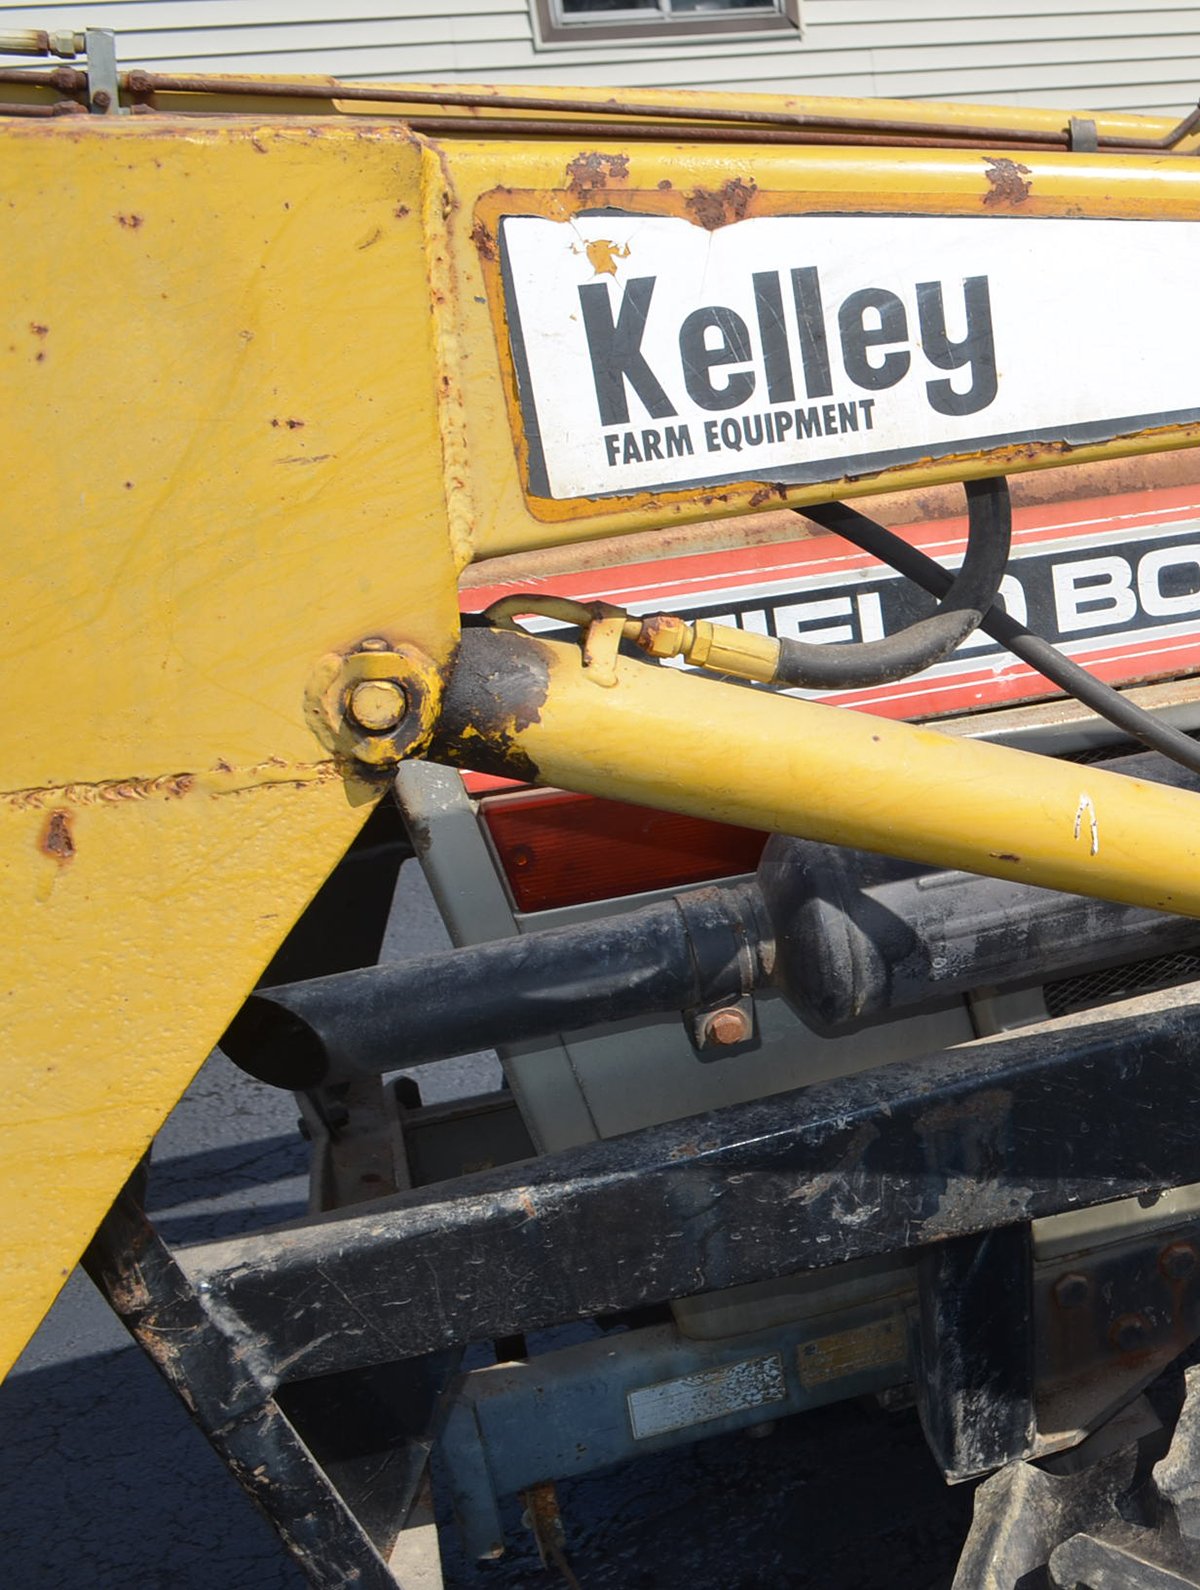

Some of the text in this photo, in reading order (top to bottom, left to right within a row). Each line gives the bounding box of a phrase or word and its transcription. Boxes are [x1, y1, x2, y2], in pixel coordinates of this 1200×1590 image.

[577, 266, 998, 426] Kelley
[604, 398, 875, 466] FARM EQUIPMENT
